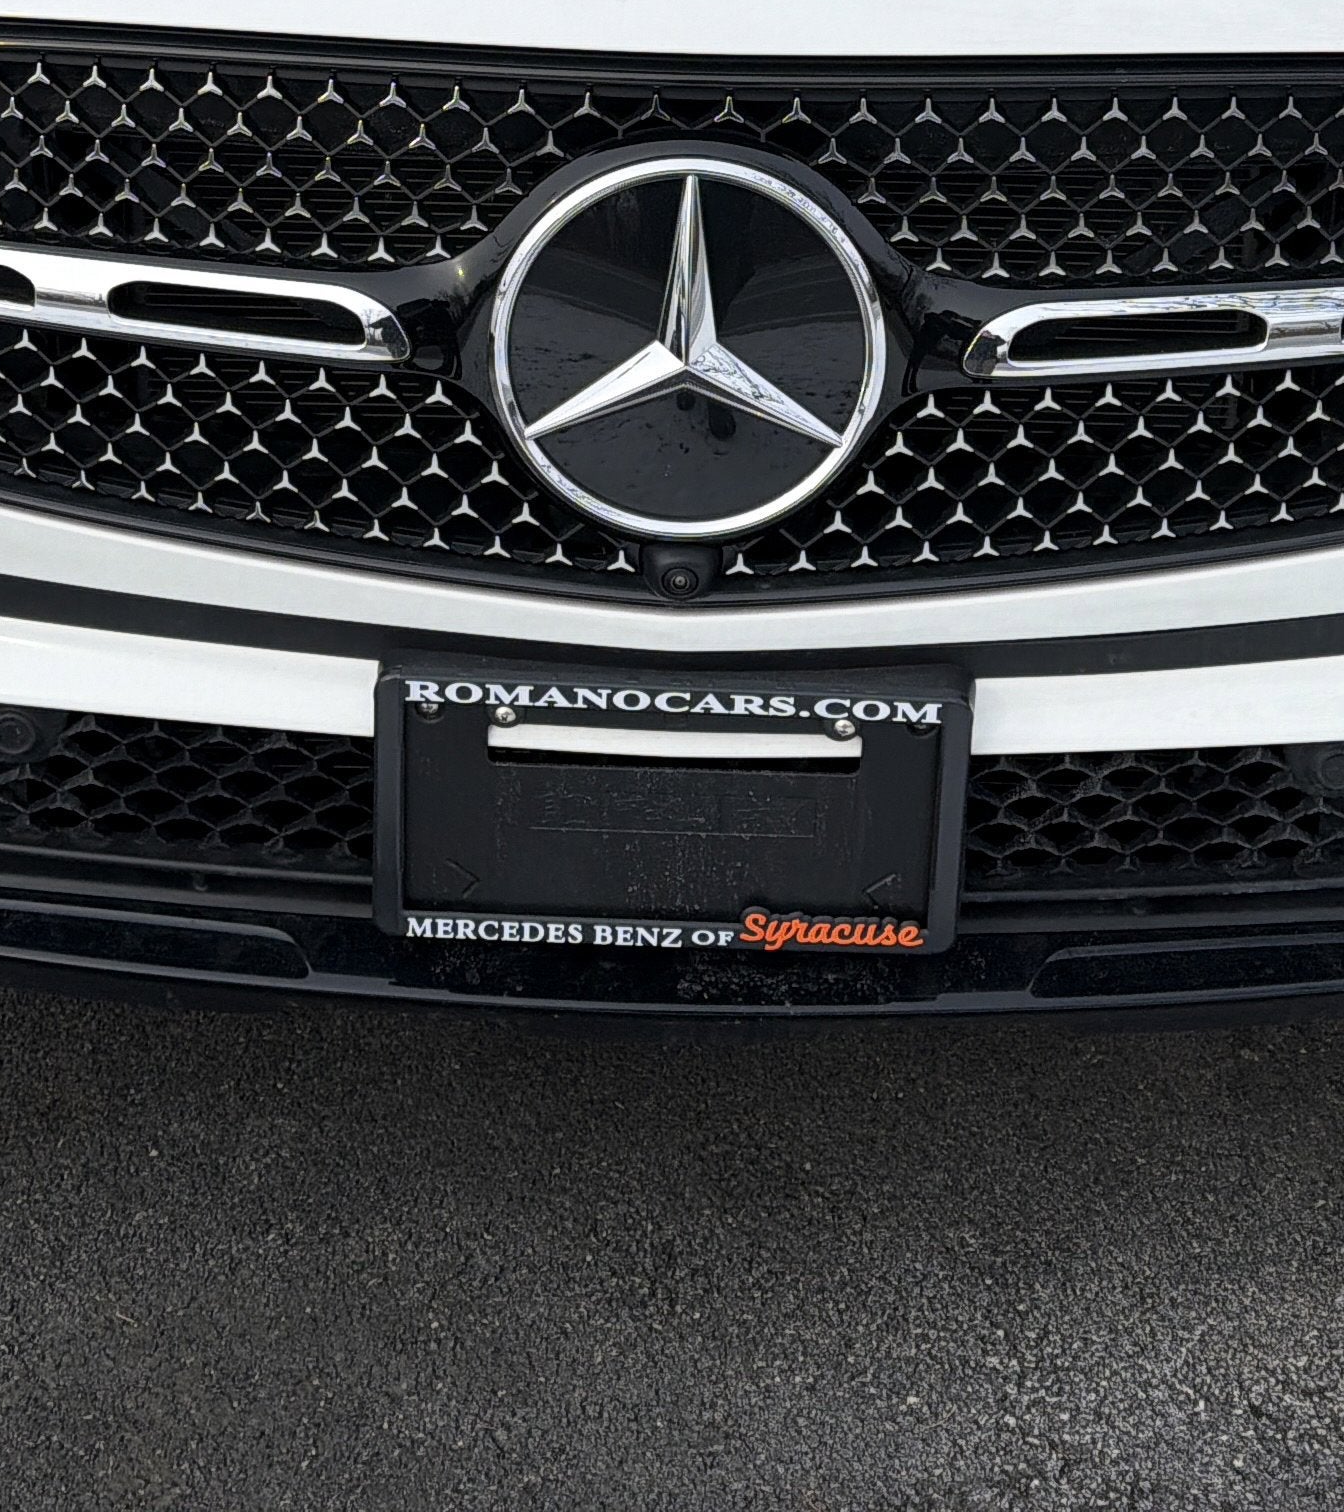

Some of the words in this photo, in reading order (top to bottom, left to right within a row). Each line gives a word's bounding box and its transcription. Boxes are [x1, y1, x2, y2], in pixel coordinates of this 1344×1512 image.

[404, 679, 943, 725] ROMANOCARS.COM
[405, 916, 584, 945] MERCEDES
[593, 924, 683, 948] BENZ
[690, 929, 735, 947] OF
[738, 911, 925, 952] Syracuse
